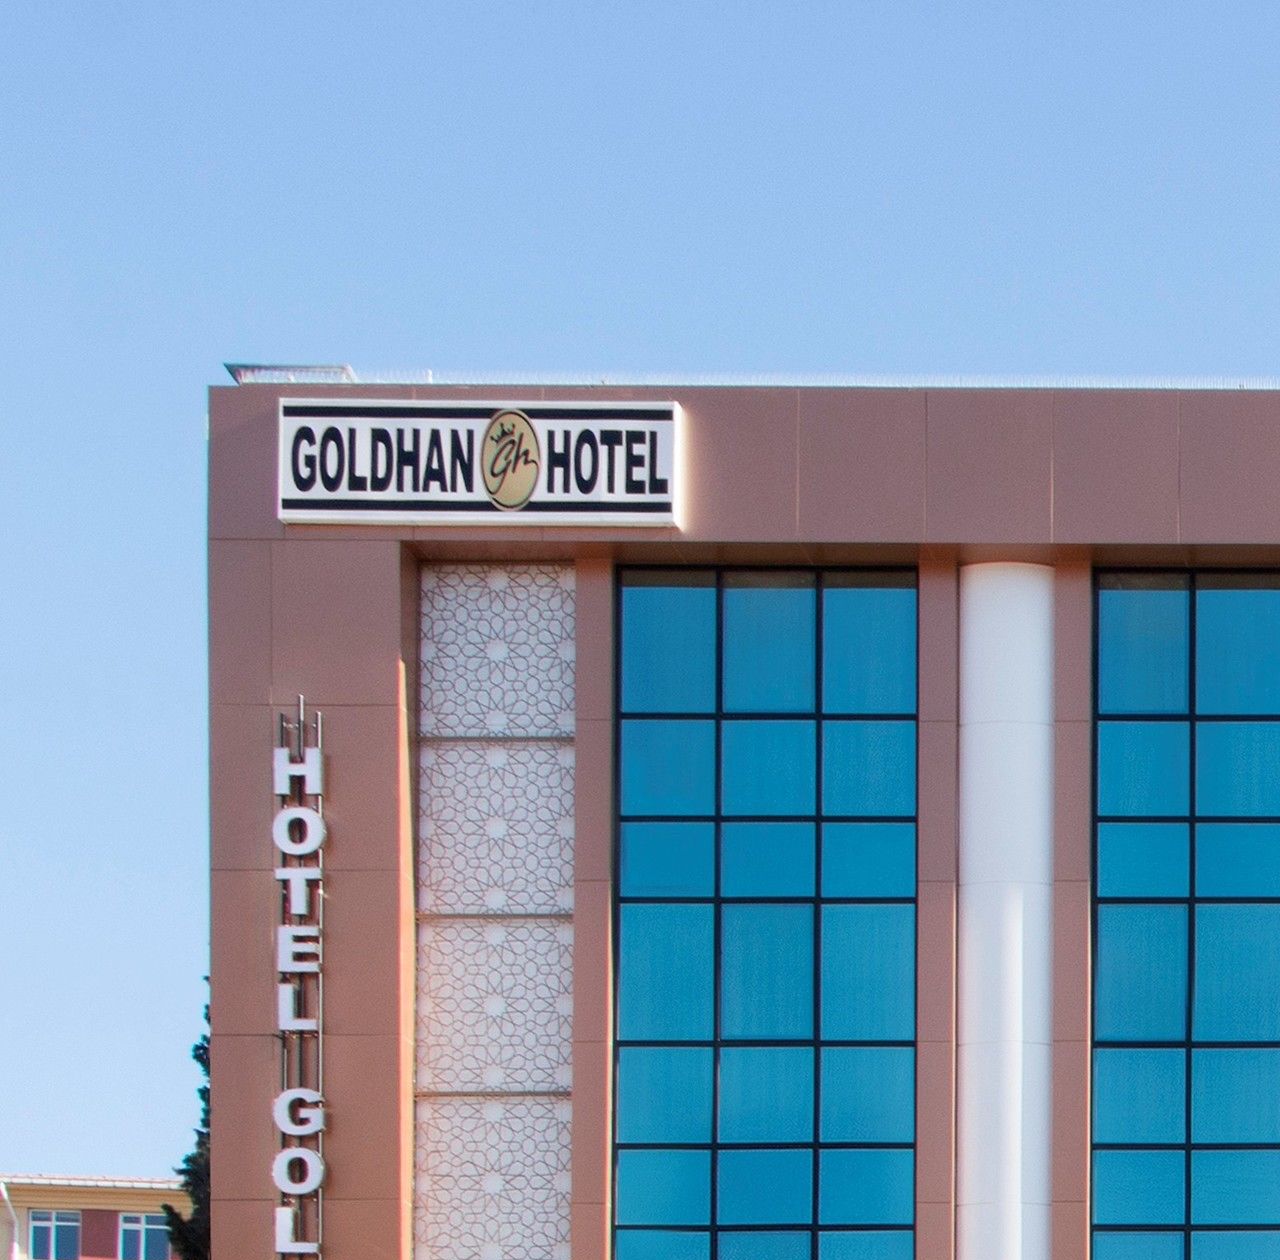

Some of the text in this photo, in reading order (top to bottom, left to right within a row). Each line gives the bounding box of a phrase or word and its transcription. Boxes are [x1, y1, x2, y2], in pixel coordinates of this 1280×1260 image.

[291, 426, 474, 492] GOLDHAN
[547, 429, 669, 495] HOTEL
[272, 747, 326, 1031] HOTEL
